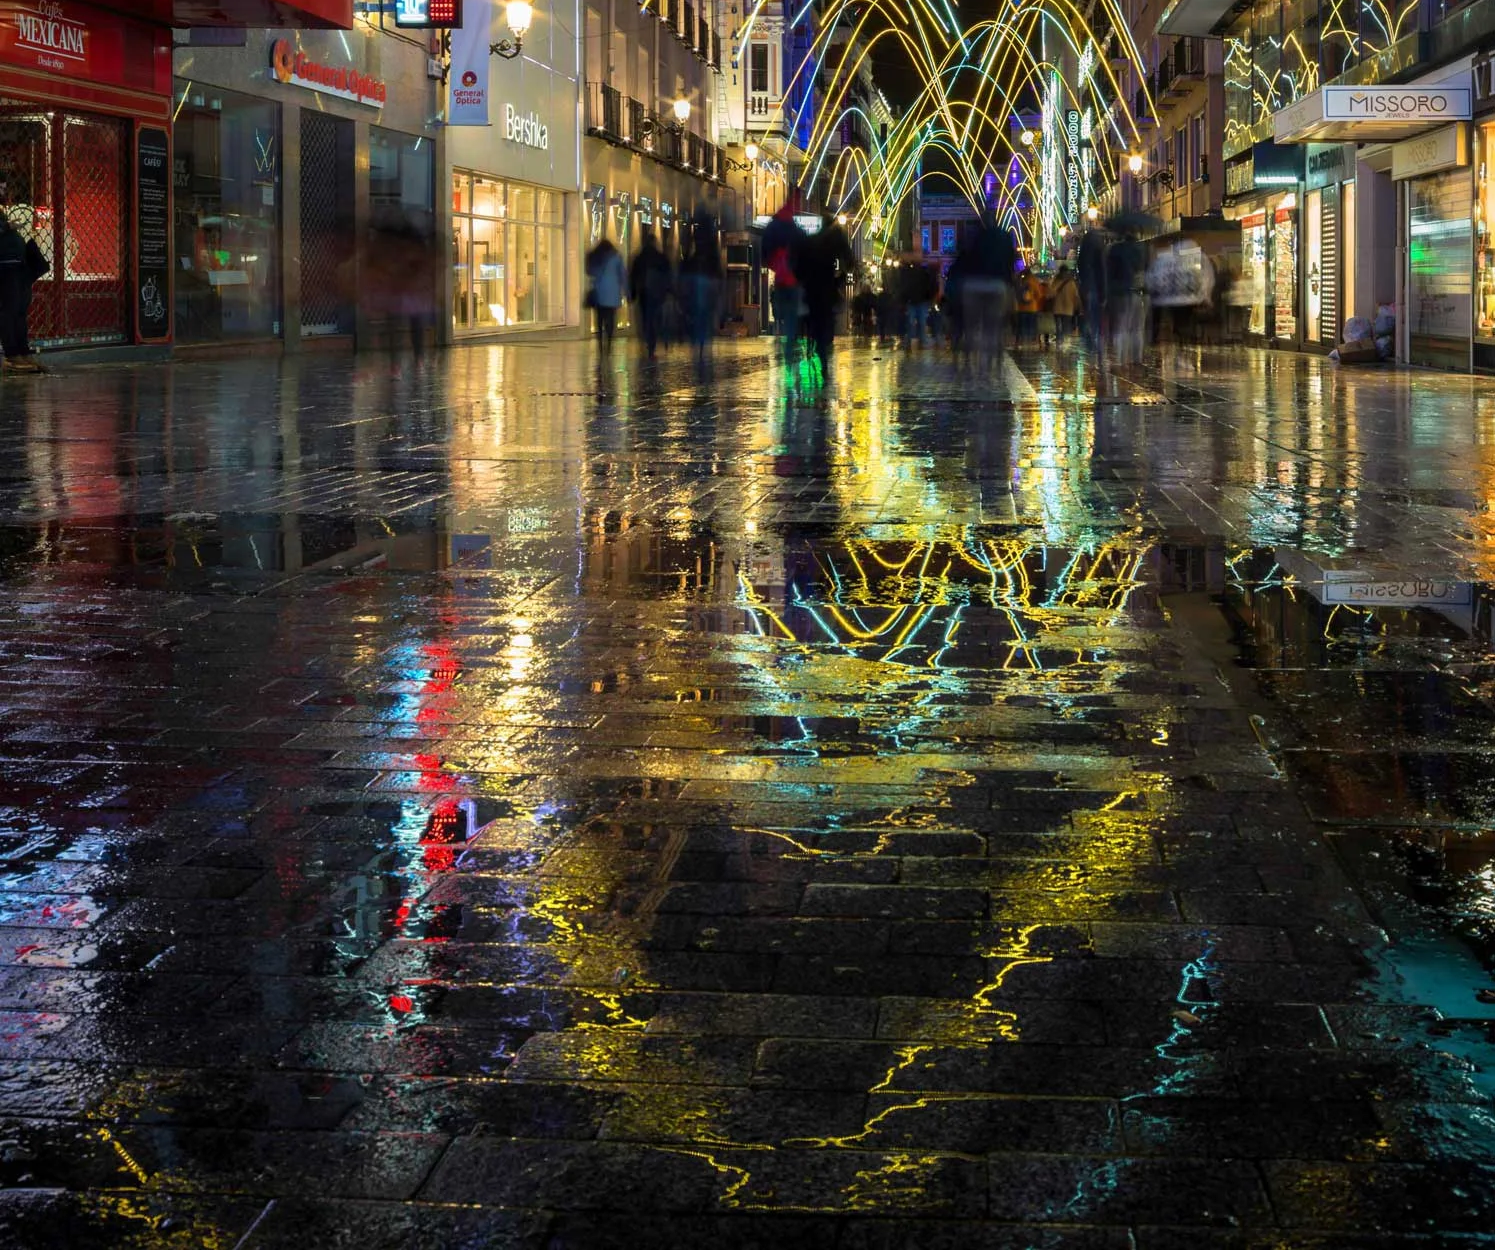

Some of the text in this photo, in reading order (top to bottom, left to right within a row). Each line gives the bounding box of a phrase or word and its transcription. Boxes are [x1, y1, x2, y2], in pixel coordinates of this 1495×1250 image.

[38, 0, 63, 20] Cafés
[19, 13, 84, 54] MEXICANA
[296, 52, 386, 103] General Optica
[454, 89, 484, 98] General
[456, 97, 481, 106] Optica
[1350, 95, 1447, 112] MISSORO
[506, 103, 547, 150] Bershka
